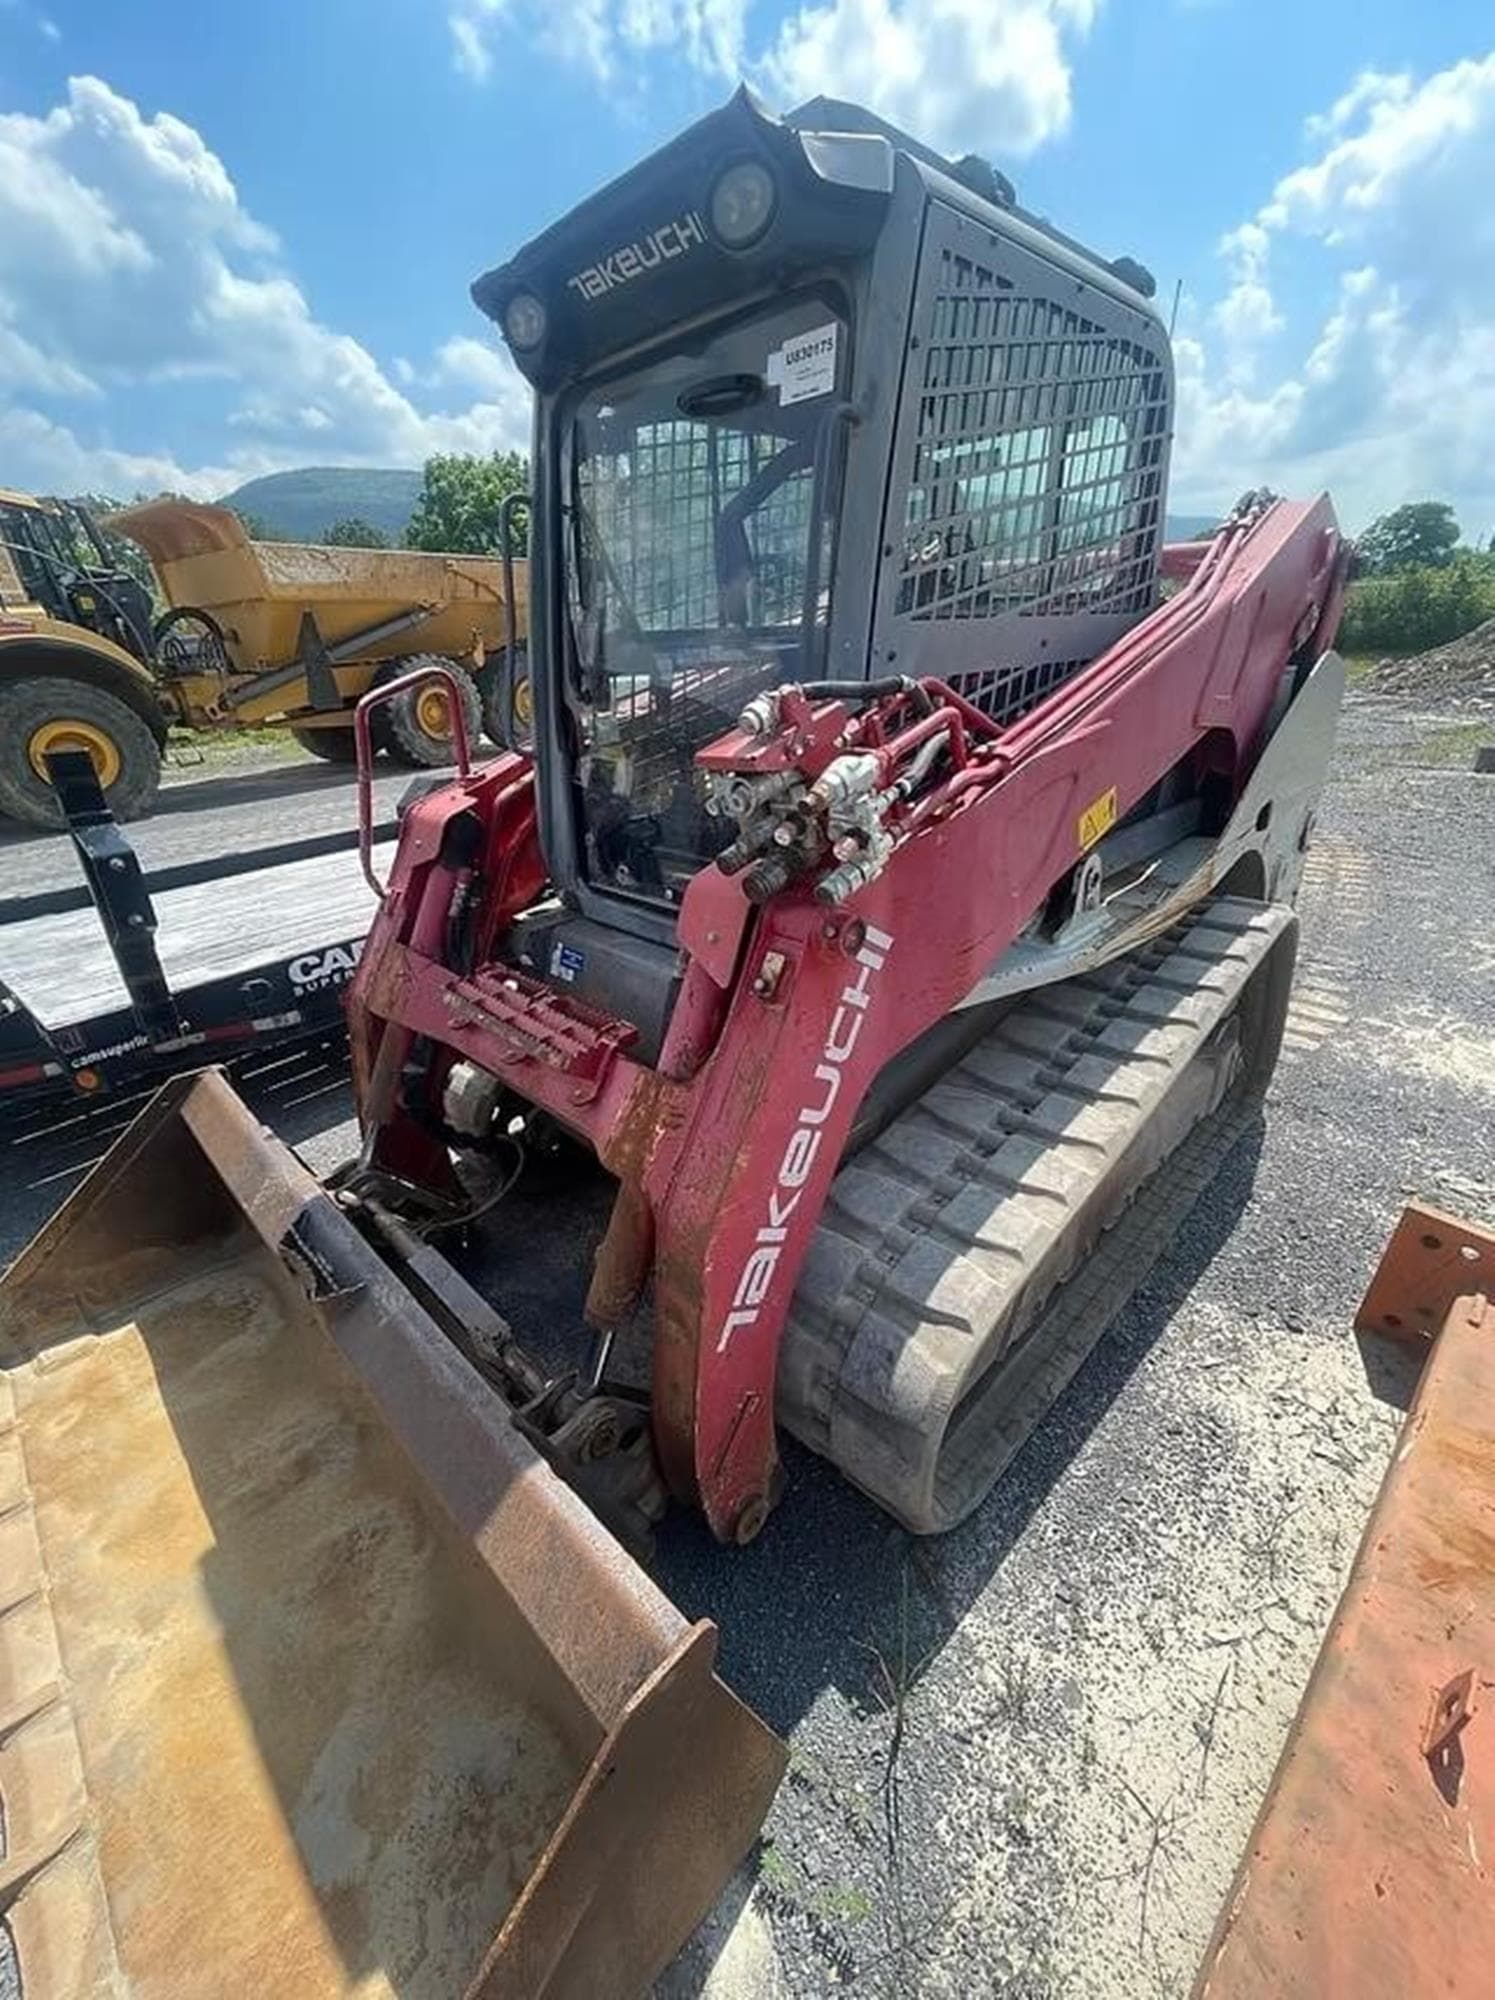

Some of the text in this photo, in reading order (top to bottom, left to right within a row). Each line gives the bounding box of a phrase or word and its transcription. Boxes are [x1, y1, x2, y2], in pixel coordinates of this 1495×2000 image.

[567, 211, 708, 300] TAKEUCHI
[786, 337, 833, 365] U830175
[717, 924, 894, 1354] TAKEUCHI
